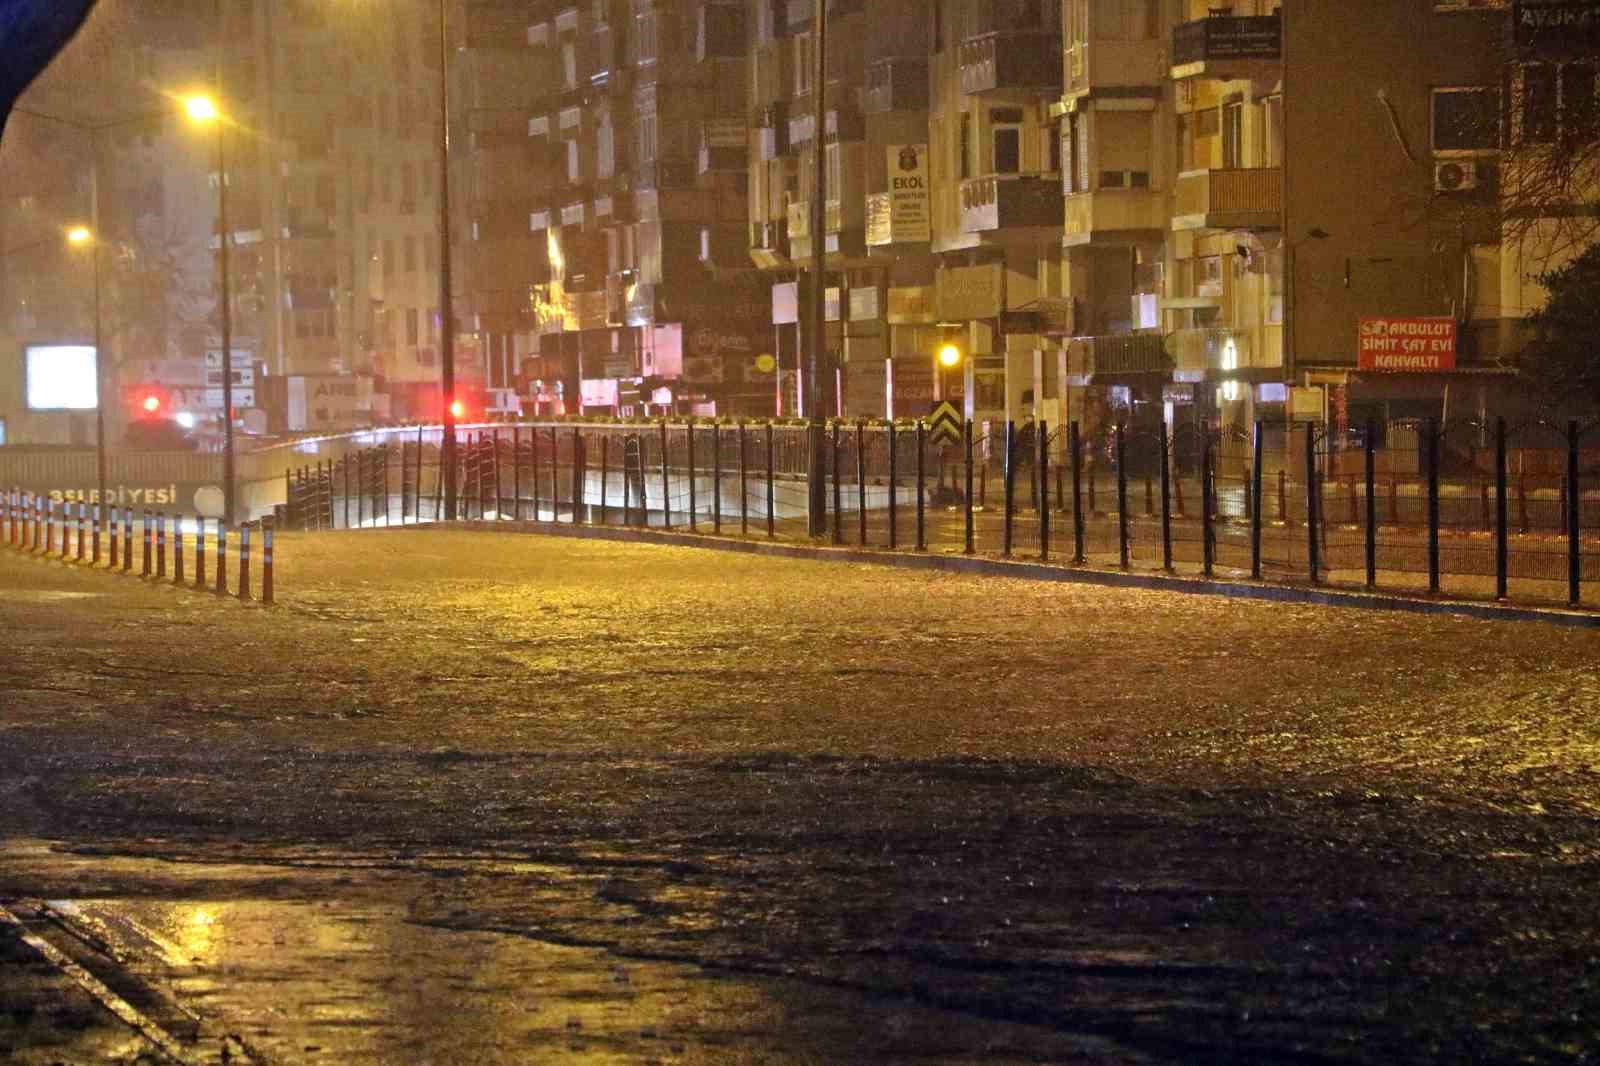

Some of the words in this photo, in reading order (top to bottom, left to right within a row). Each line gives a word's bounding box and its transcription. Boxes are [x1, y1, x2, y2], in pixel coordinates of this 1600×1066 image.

[893, 177, 924, 190] EKOL
[1390, 322, 1451, 336] AKBULUT
[1362, 336, 1397, 350] SİMİT
[1401, 338, 1426, 353] ÇAY
[1431, 337, 1452, 352] EVİ
[1375, 355, 1439, 368] KAHVALTI
